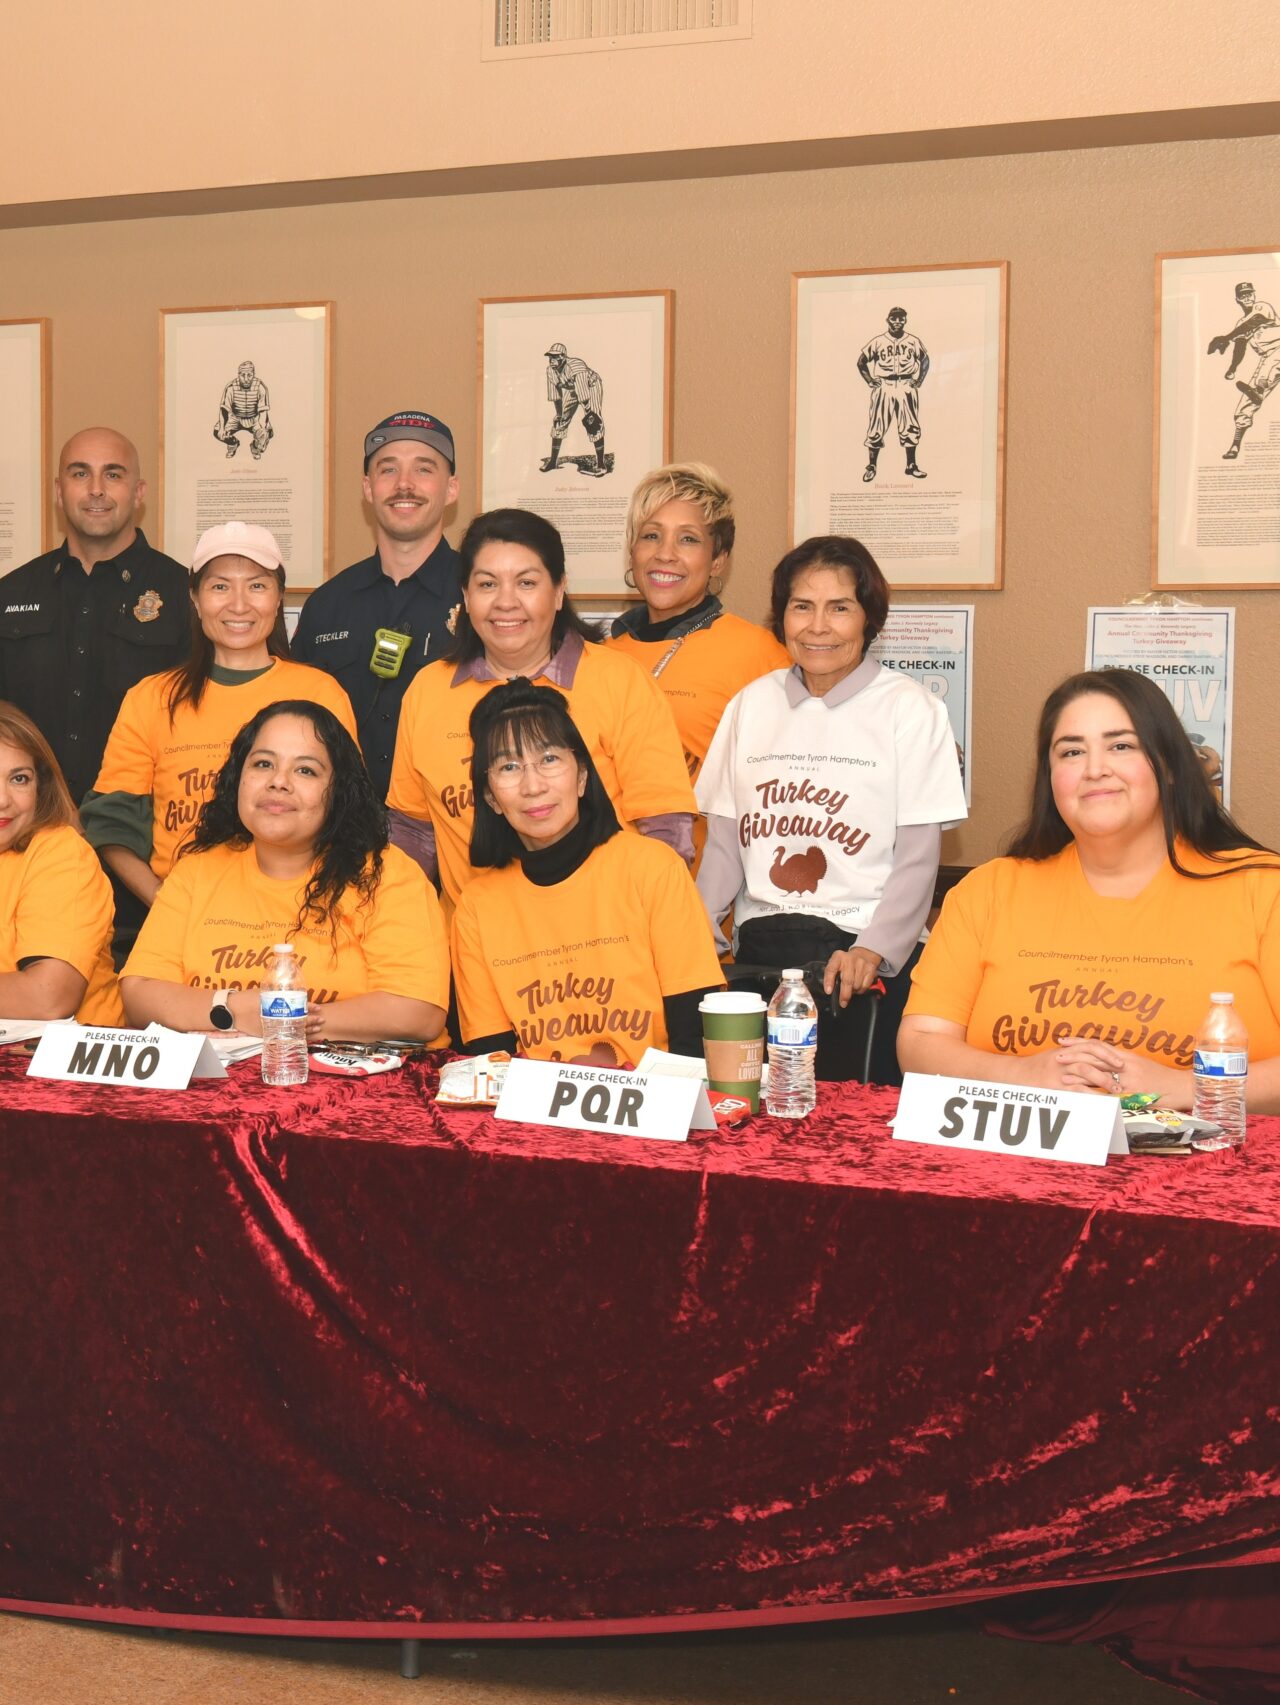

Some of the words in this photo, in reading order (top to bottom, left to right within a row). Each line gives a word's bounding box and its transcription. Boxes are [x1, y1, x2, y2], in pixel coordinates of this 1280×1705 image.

[880, 344, 913, 361] GRAYS
[394, 414, 430, 422] PASADENA
[5, 603, 40, 613] AVAKIAN
[315, 630, 349, 645] STECKLER
[901, 634, 929, 642] Giveaway
[914, 627, 954, 635] Thanksgiving
[1132, 630, 1168, 638] Cunity
[1170, 630, 1213, 638] Thanksgiving
[898, 660, 955, 670] CHECK-IN
[1153, 665, 1215, 675] CHECK-IN
[664, 689, 697, 699] mpton's
[164, 741, 221, 755] Councilmember
[746, 753, 806, 765] Councilmember
[807, 753, 828, 764] Tyron
[829, 754, 877, 768] Hampton's
[178, 767, 220, 797] Tur
[756, 778, 849, 816] Turkey
[739, 812, 871, 856] Giveaway
[832, 906, 861, 917] Legacy
[212, 944, 307, 973] Turk
[492, 946, 562, 968] Councilmember
[562, 939, 584, 954] Tyron
[585, 934, 630, 951] Hampton's
[1018, 949, 1098, 963] Councilmember
[1100, 953, 1130, 966] Tyron
[1132, 954, 1194, 967] Hampton's
[517, 972, 615, 1015] Turkey
[1029, 979, 1165, 1024] Turkey
[521, 1007, 652, 1050] iveaway
[85, 1031, 116, 1042] PLEASE
[118, 1033, 160, 1044] CHECK-IN
[992, 1014, 1195, 1067] Giveaway
[67, 1041, 160, 1080] MNO
[747, 1049, 758, 1060] ALL
[558, 1069, 597, 1082] PLEASE
[598, 1073, 648, 1087] CHECK-IN
[958, 1085, 1000, 1099] PLEASE
[1002, 1089, 1058, 1105] CHECK-IN
[548, 1081, 645, 1129] PQR
[938, 1096, 1071, 1150] STUV
